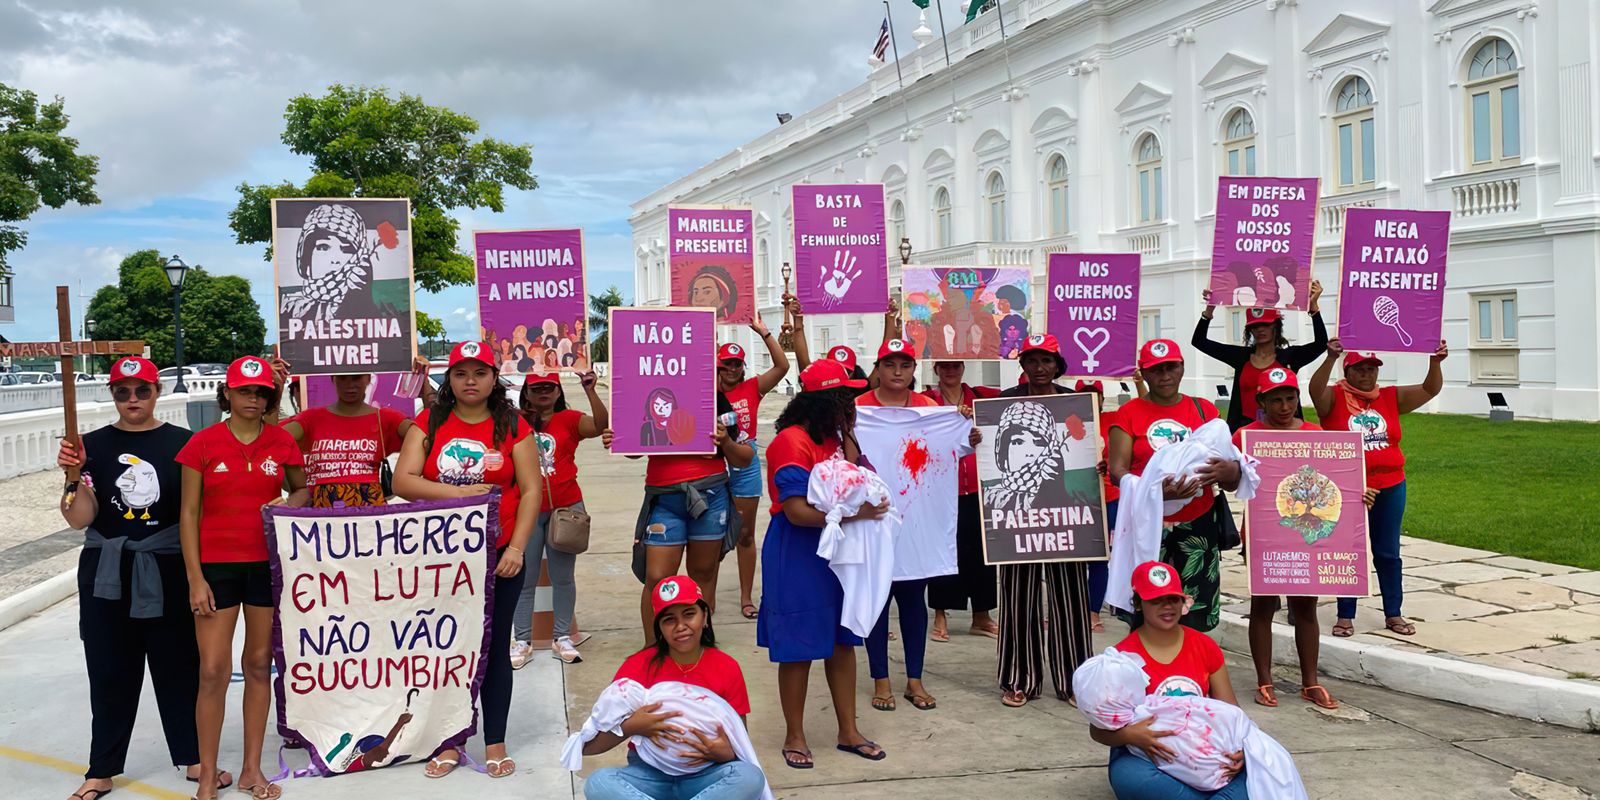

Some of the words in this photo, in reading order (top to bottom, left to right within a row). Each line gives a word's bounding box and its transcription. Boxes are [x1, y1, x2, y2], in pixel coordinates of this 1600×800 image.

[815, 194, 862, 209] BASTA
[1228, 183, 1249, 199] EM
[1253, 185, 1306, 201] DEFESA
[1251, 203, 1280, 218] DOS
[677, 217, 744, 233] MARIELLE
[832, 216, 847, 228] DE
[1236, 220, 1292, 236] NOSSOS
[1374, 219, 1419, 240] NEGA
[675, 238, 748, 254] PRESENTE!
[800, 232, 881, 247] FEMINICÍDIOS!
[1235, 237, 1291, 254] CORPOS
[485, 248, 574, 269] NENHUMA
[1360, 244, 1429, 265] PATAXÓ
[1079, 261, 1109, 277] NOS
[488, 283, 501, 301] A
[507, 278, 575, 301] MENOS!
[1348, 271, 1439, 291] PRESENTE!
[1054, 284, 1133, 302] QUEREMOS
[1068, 305, 1117, 321] VIVAS!
[288, 318, 402, 340] PALESTINA
[633, 322, 674, 344] NÃO
[681, 322, 692, 344] É
[0, 341, 124, 357] MARIELLE
[313, 342, 379, 366] LIVRE!
[639, 354, 687, 376] NÃO!
[1253, 449, 1293, 458] MULHERES
[1294, 449, 1310, 458] SEM
[1312, 450, 1336, 459] TERRA
[1338, 451, 1356, 459] 2024
[991, 506, 1095, 530] PALESTINA
[289, 510, 485, 562] MULHERES
[1015, 529, 1075, 554] LIVRE!
[291, 570, 349, 613] EM
[373, 561, 475, 601] LUTA
[299, 614, 370, 657] NÃO
[390, 608, 458, 651] VÃO
[290, 651, 476, 695] SUCUMBIR!
